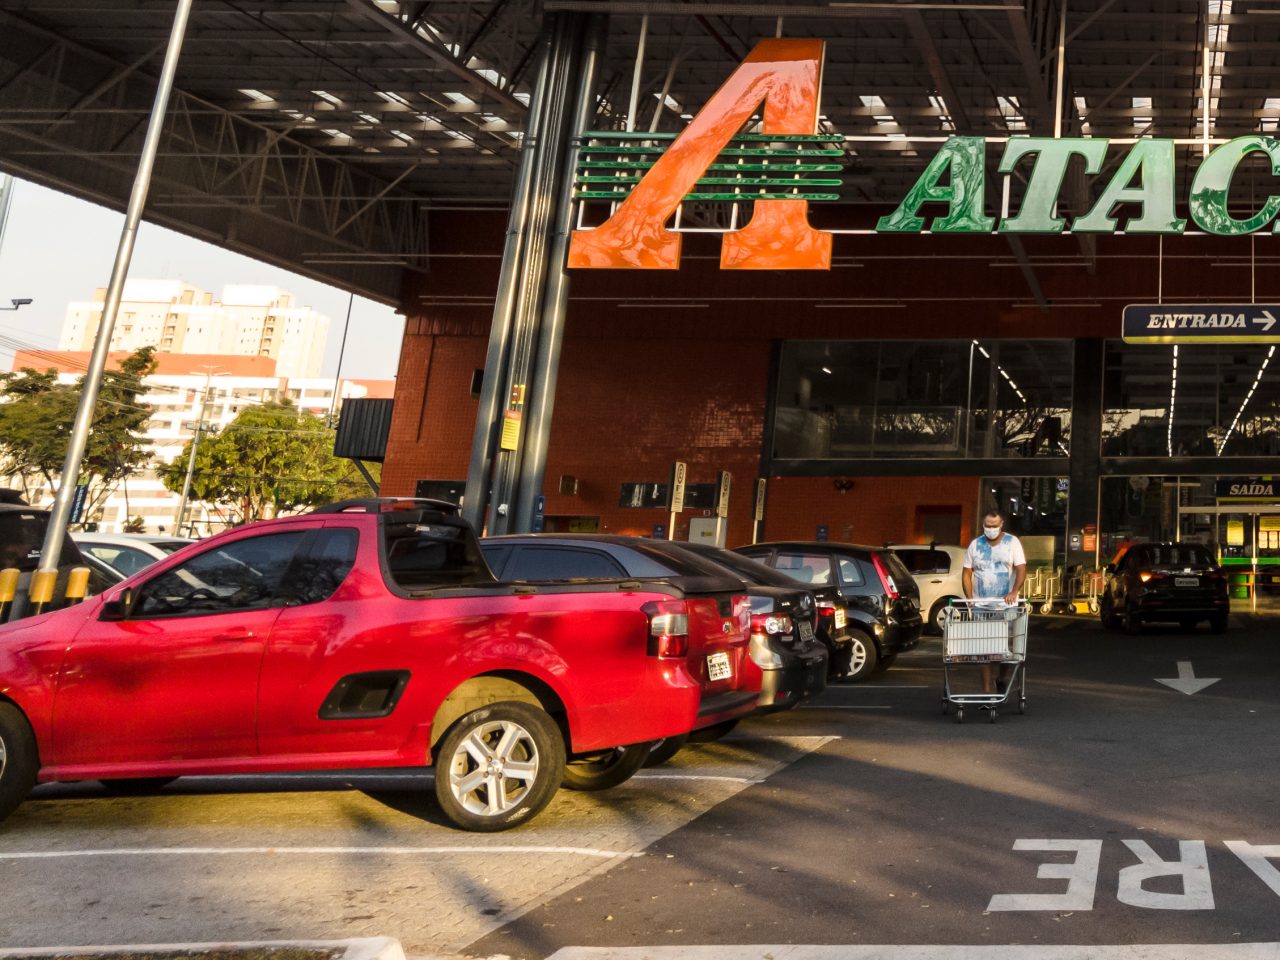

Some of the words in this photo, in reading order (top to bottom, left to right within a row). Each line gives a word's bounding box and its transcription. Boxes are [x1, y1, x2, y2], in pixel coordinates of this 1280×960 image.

[567, 38, 833, 271] A
[1146, 313, 1247, 329] ENTRADA
[1229, 481, 1274, 496] SAÍDA
